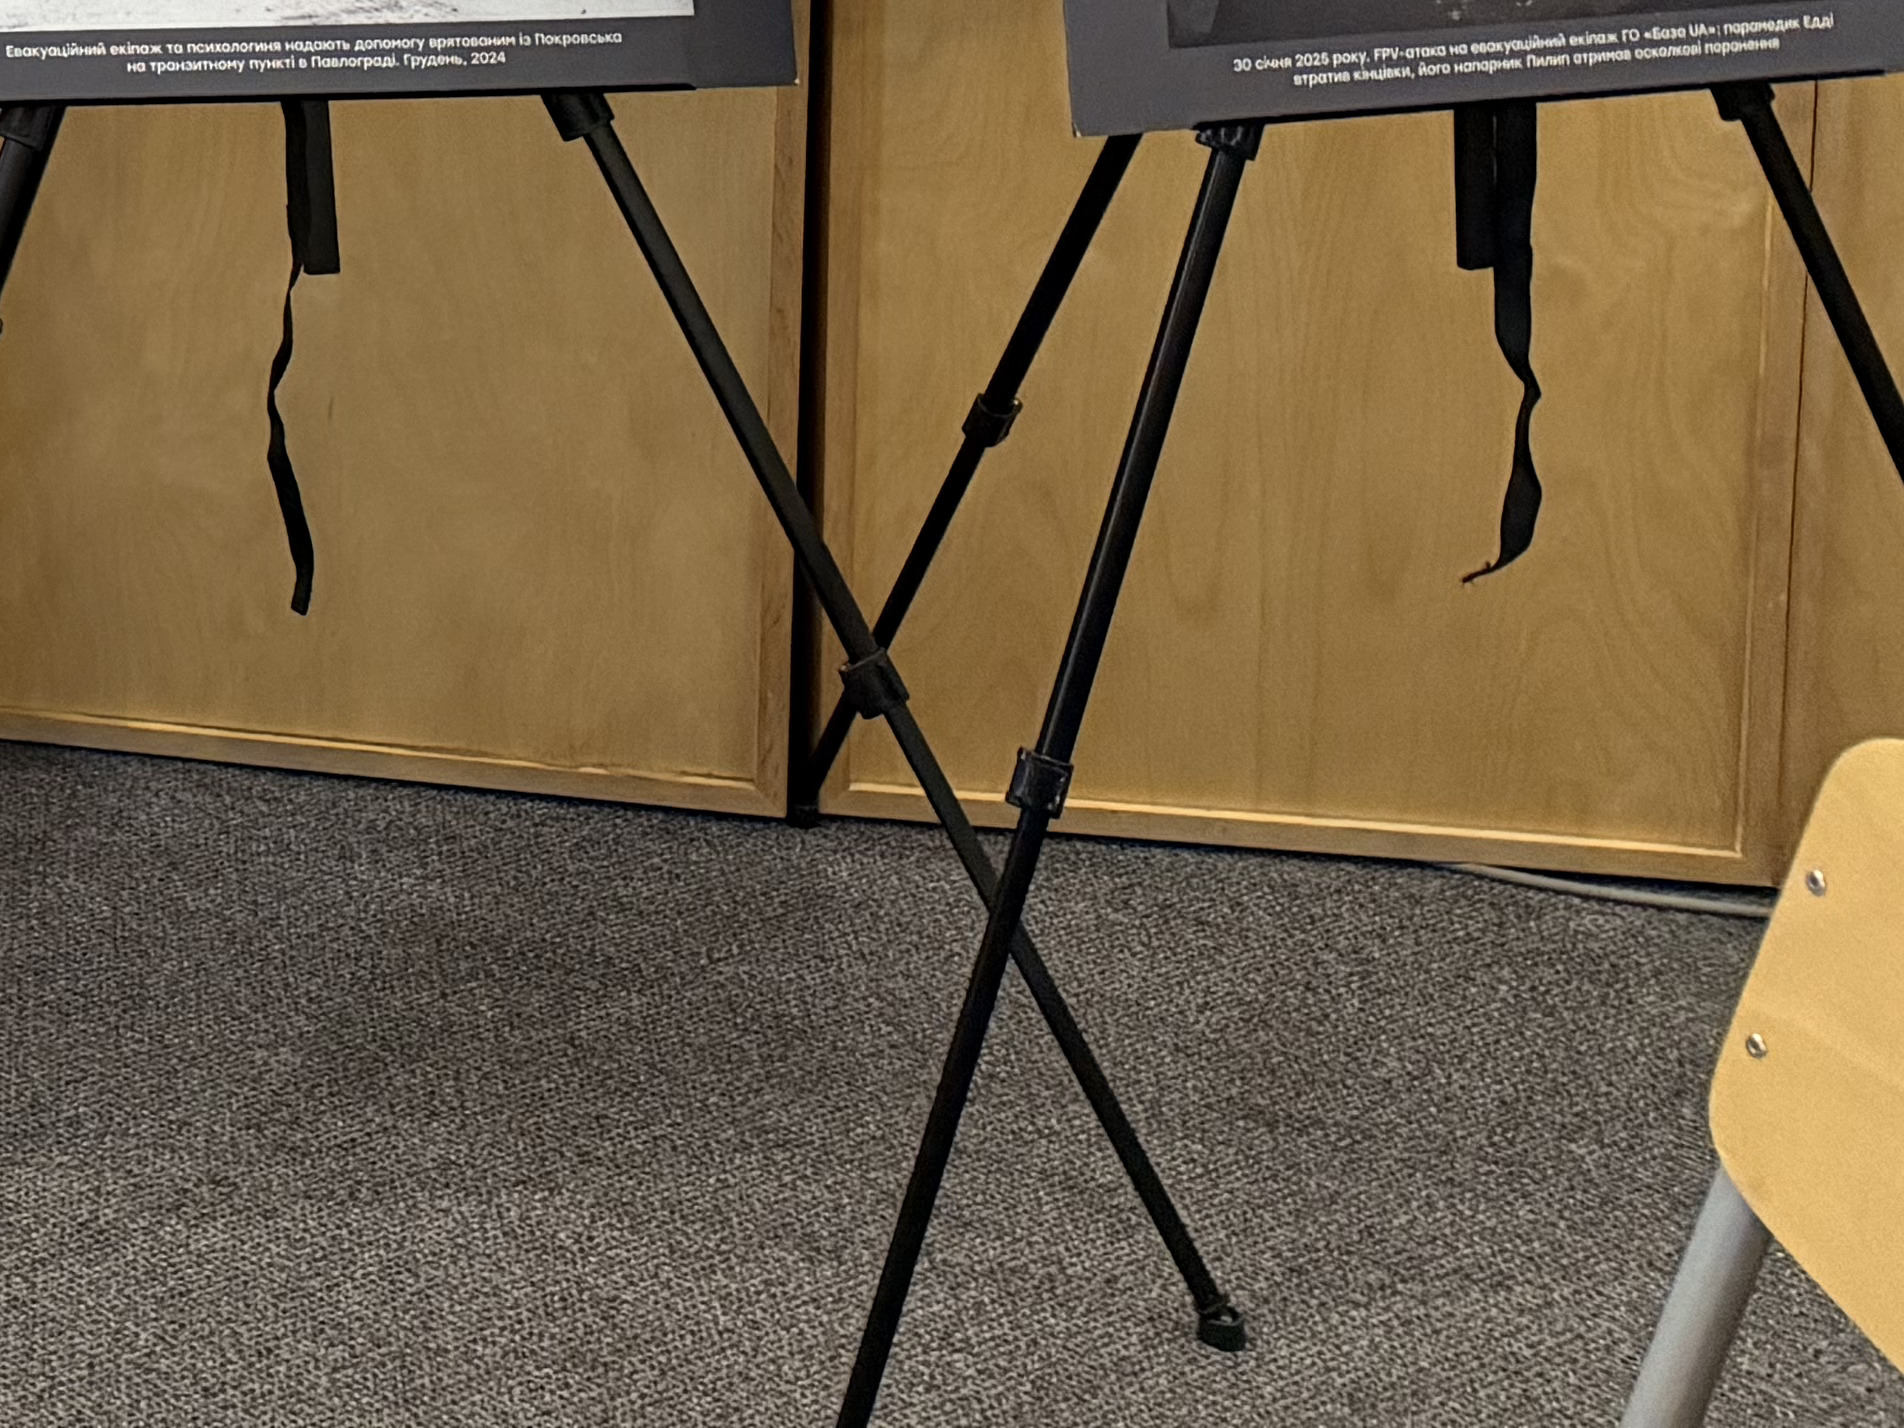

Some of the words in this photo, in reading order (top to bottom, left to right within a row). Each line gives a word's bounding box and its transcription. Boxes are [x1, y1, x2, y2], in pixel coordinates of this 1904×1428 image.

[5, 41, 106, 60] Евакуаційний
[109, 41, 163, 55] екіпаж
[165, 43, 183, 54] та
[186, 41, 281, 53] психологиня
[284, 39, 350, 52] надають
[353, 38, 425, 51] допомогу
[428, 36, 516, 51] врятованим
[518, 32, 531, 45] із
[534, 32, 622, 47] Покровська
[126, 61, 146, 72] на
[149, 59, 245, 75] транзитному
[249, 54, 295, 72] пункті
[310, 52, 399, 70] Павлограді.
[403, 53, 467, 69] Грудень,
[470, 51, 505, 64] 2024
